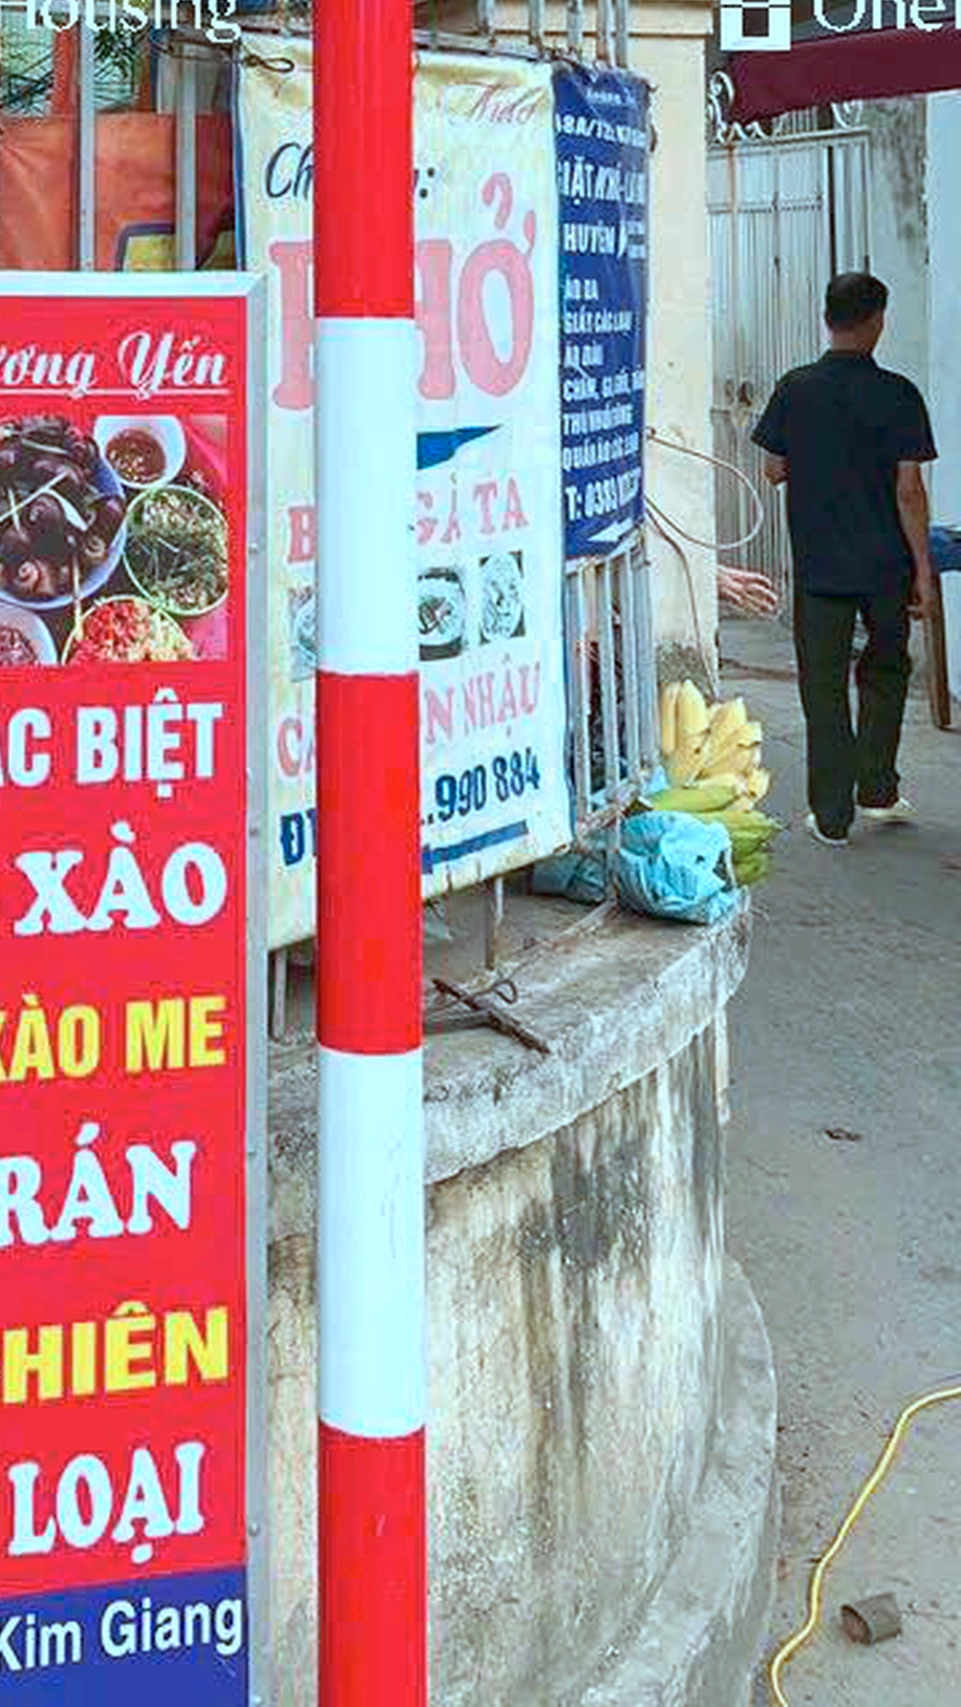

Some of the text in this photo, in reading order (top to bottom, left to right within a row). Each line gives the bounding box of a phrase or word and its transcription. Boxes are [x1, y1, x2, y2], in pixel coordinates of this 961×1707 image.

[118, 328, 227, 401] Yến
[76, 687, 224, 798] BIỆT
[14, 820, 228, 936] XÀO
[125, 995, 227, 1073] ME
[7, 1441, 206, 1564] LOẠI
[100, 1597, 243, 1657] Giang
